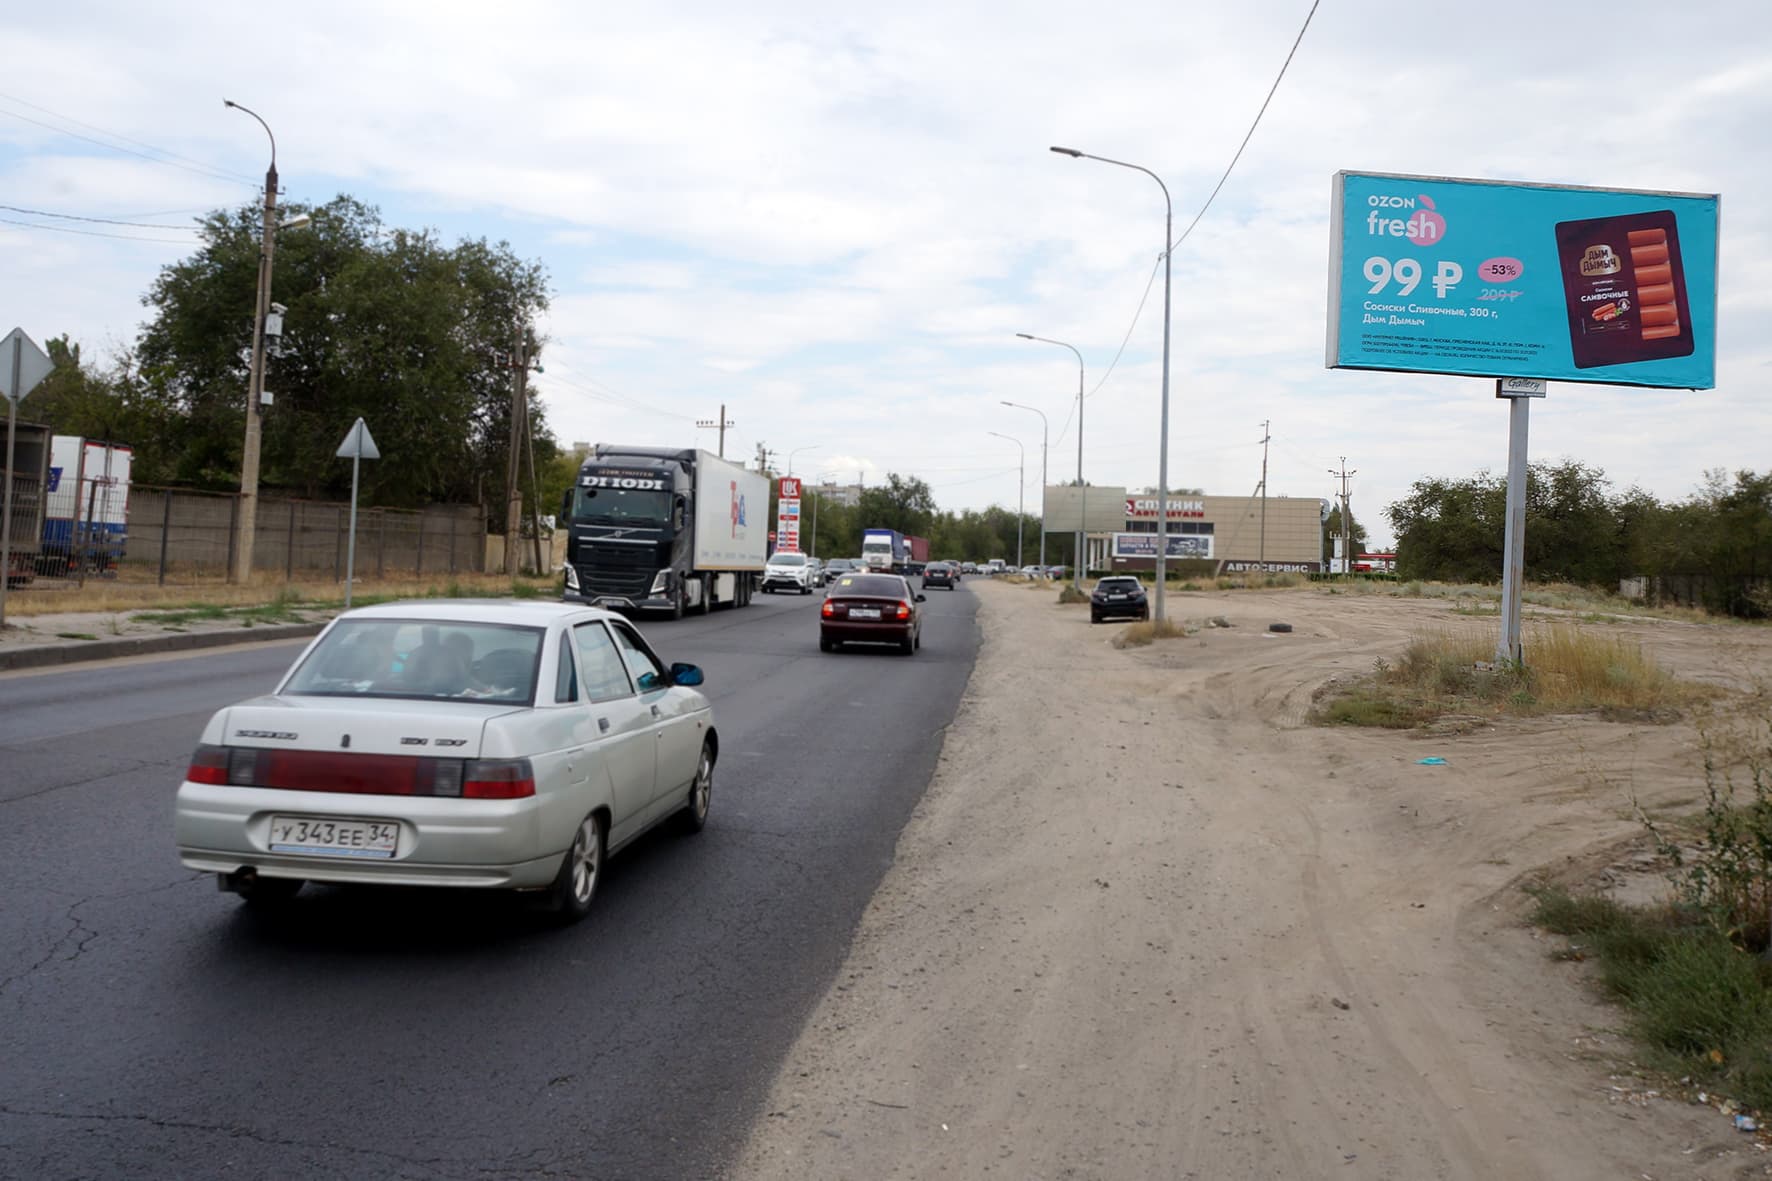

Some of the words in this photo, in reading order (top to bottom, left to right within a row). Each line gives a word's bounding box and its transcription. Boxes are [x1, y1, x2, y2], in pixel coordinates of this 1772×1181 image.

[1368, 195, 1415, 208] OZON
[1367, 210, 1436, 239] fresh
[1588, 249, 1609, 261] ДЫМ
[1583, 258, 1616, 272] ДЫМЫЧ
[1363, 256, 1422, 296] 99
[1432, 261, 1463, 298] ₽
[1580, 290, 1629, 302] СЛИВОЧНЫЕ
[1363, 301, 1406, 312] Сосиски
[1408, 303, 1467, 317] Сливочные,
[1469, 307, 1489, 317] 300
[1491, 309, 1499, 319] г,
[1362, 313, 1386, 324] Дым
[1388, 315, 1425, 326] Дымыч
[1227, 562, 1308, 573] АВТОСЕРВИС
